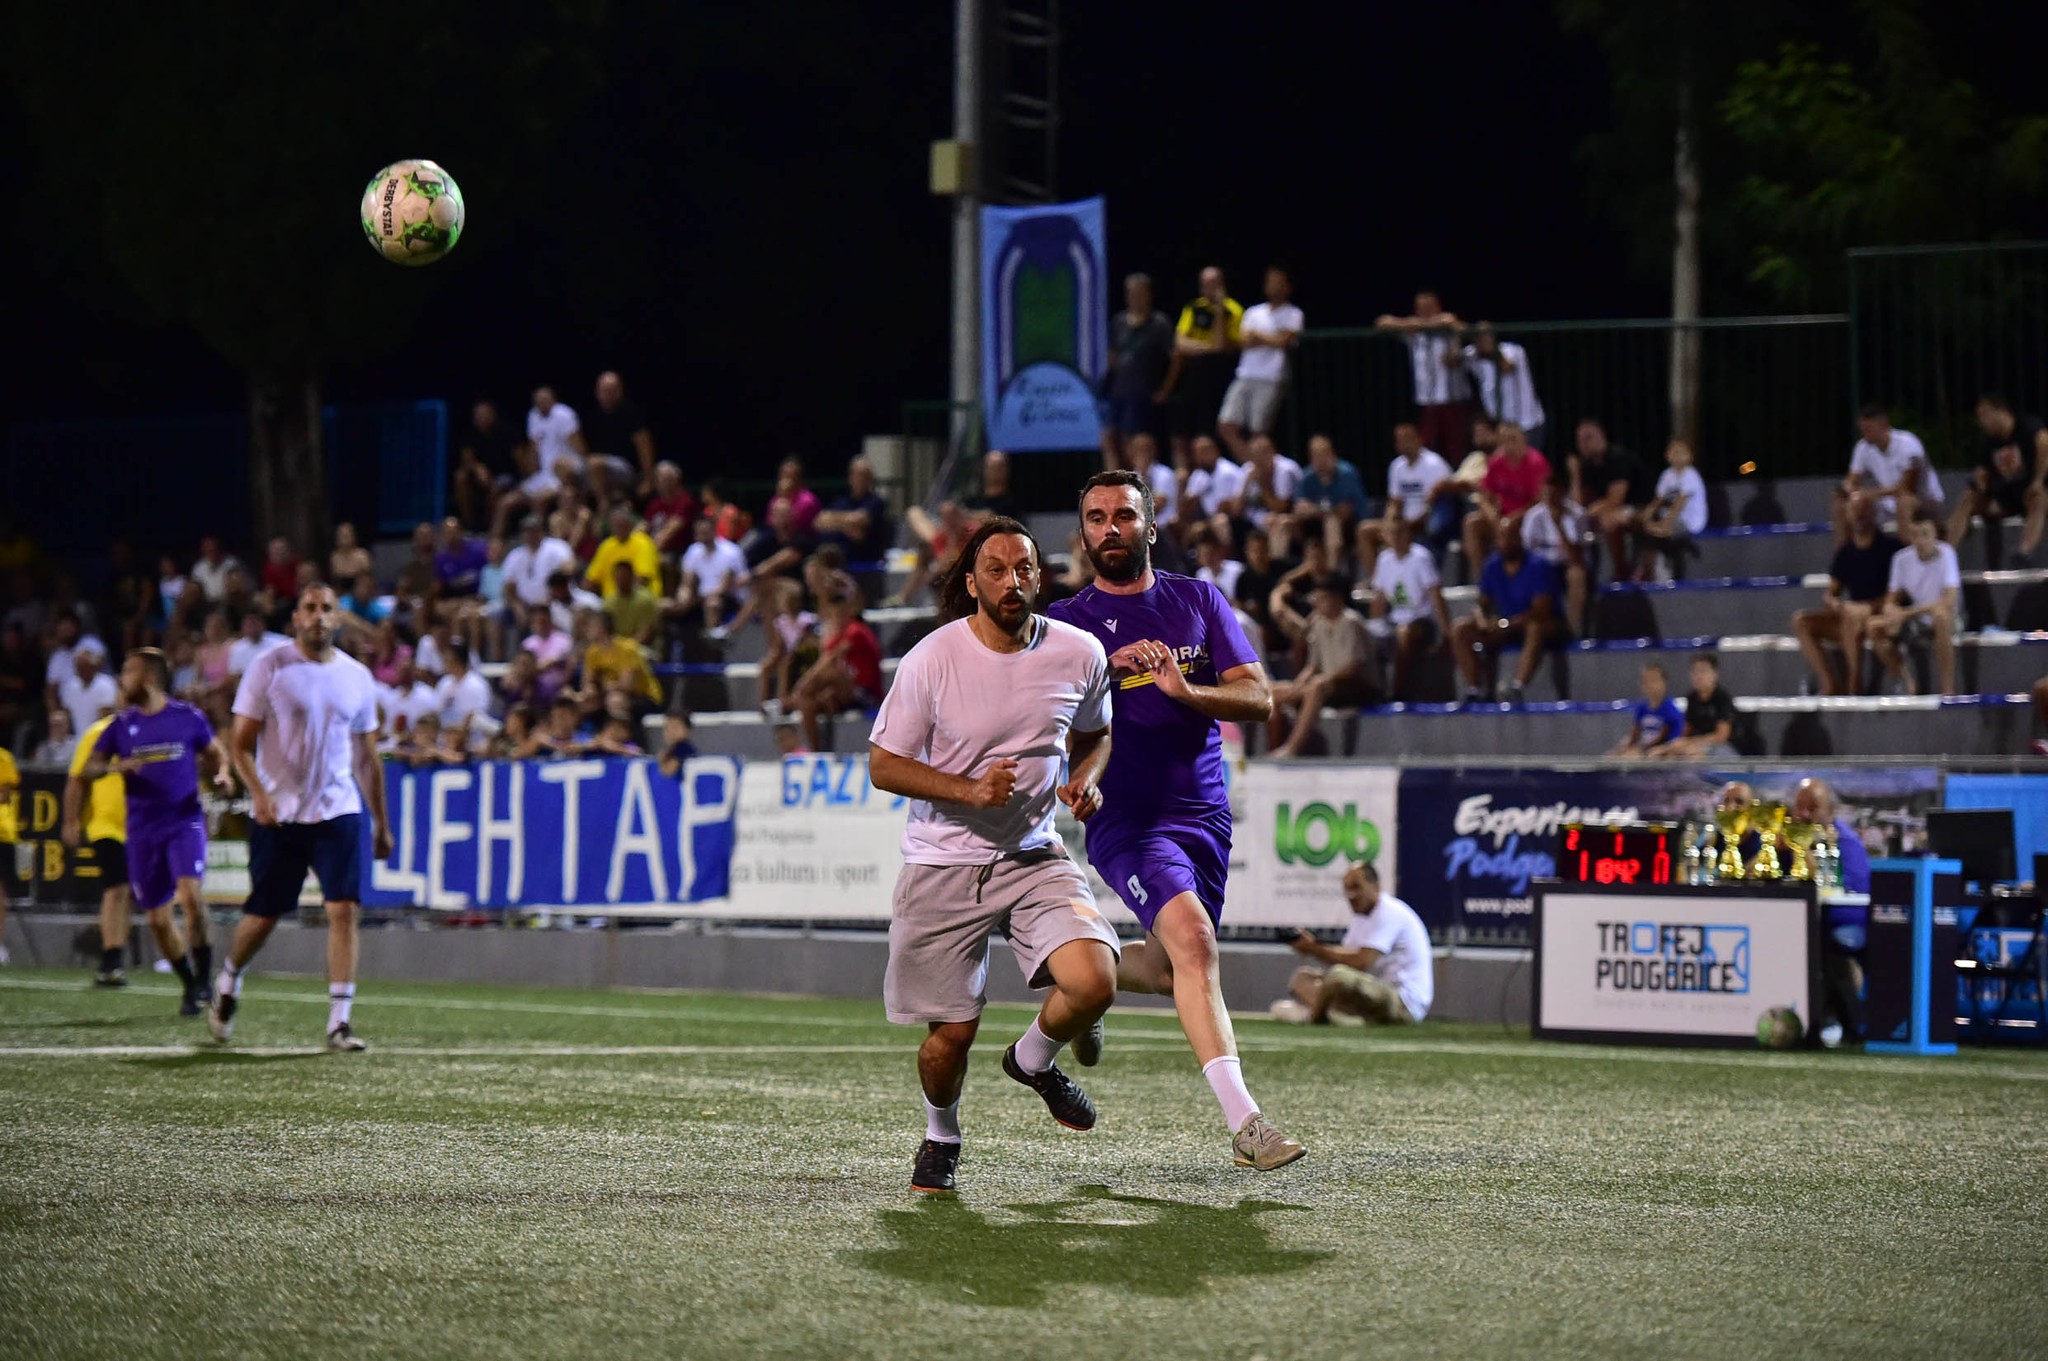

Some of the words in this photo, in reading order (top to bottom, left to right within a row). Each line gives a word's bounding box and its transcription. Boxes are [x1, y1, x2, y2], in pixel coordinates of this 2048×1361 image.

[382, 179, 399, 236] DERBYSTAR
[372, 756, 738, 911] ЦЕНТАР
[1127, 874, 1148, 906] 9
[1443, 832, 1556, 895] Podgo
[1596, 921, 1705, 955] TROFEJ
